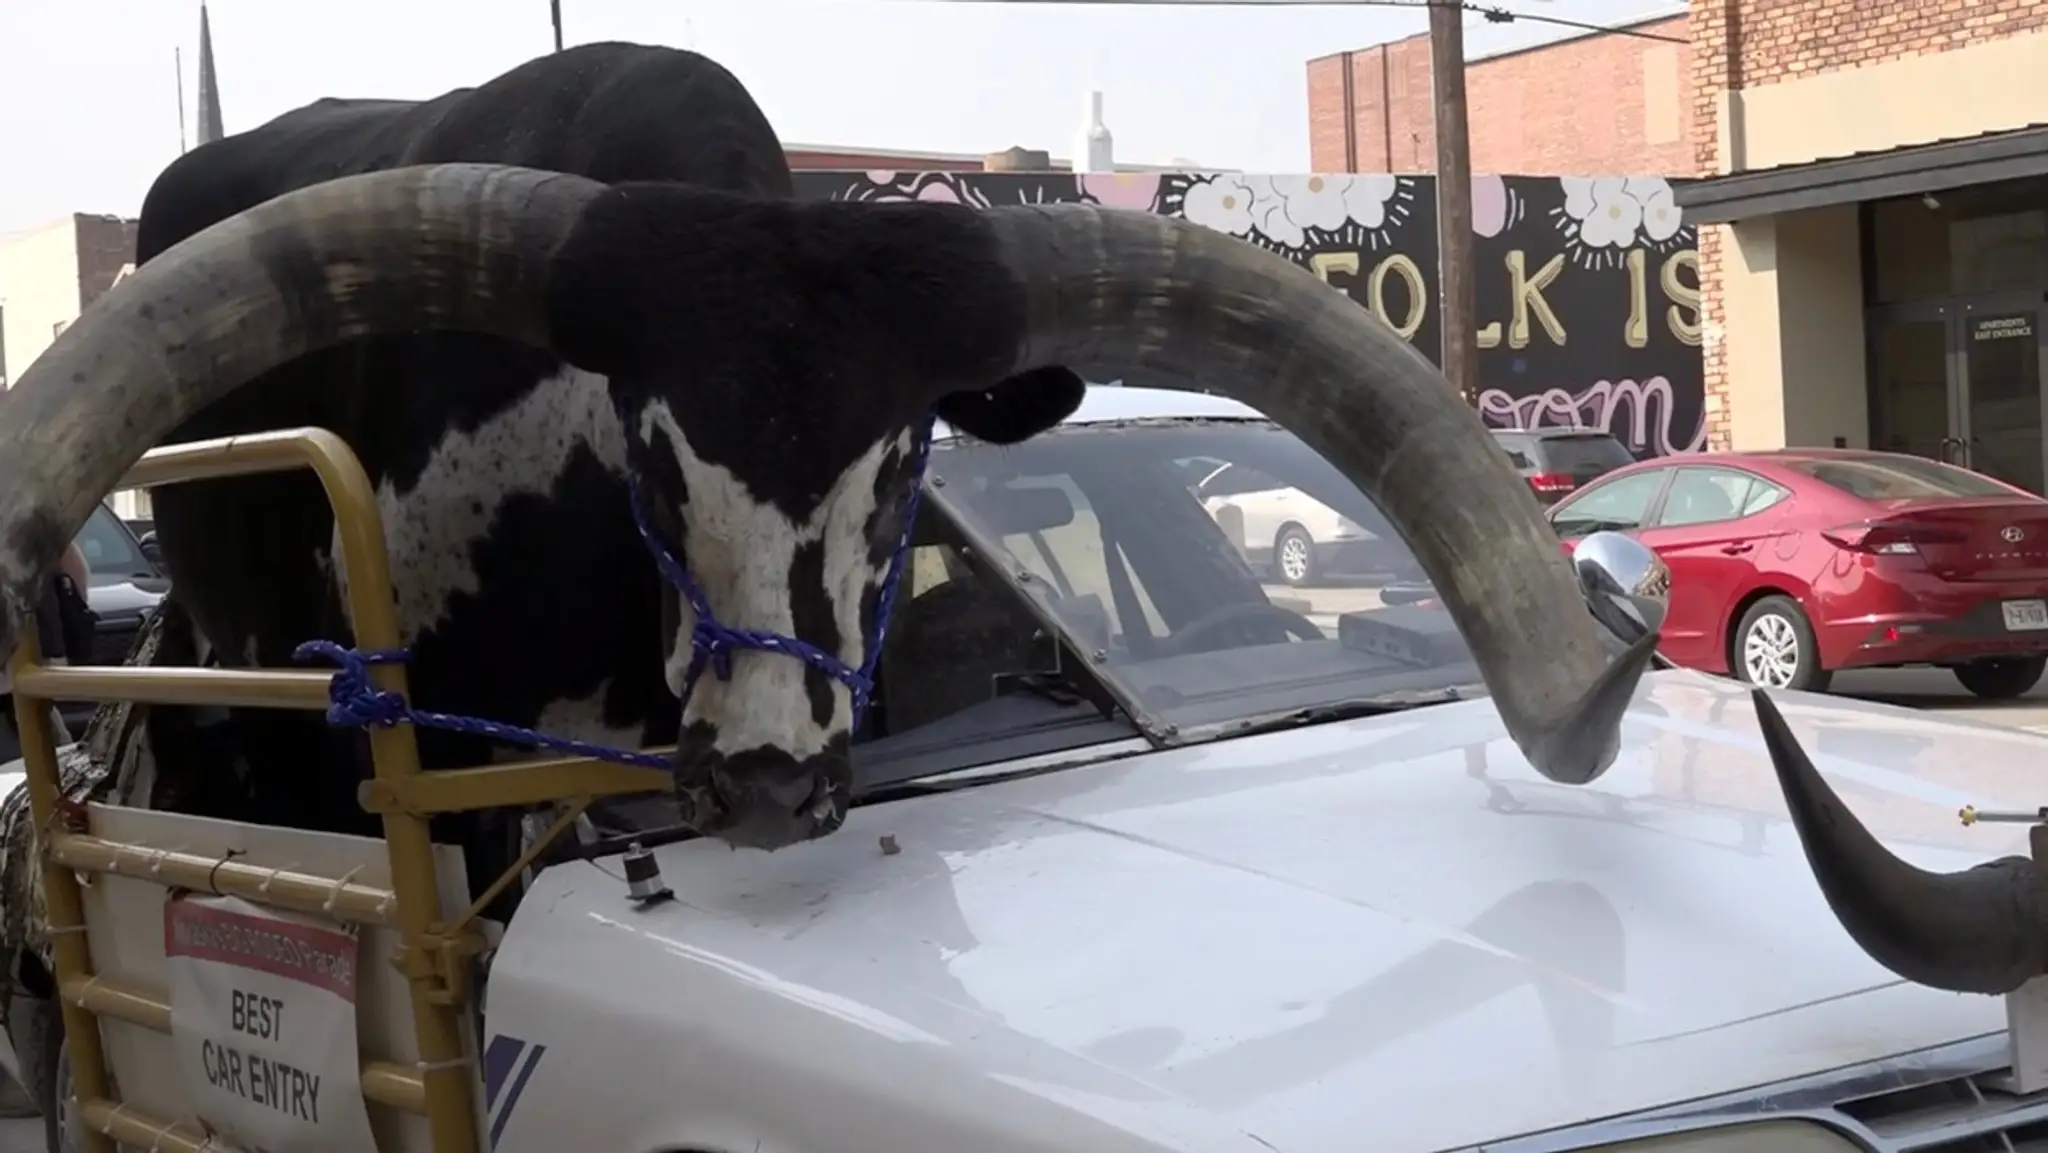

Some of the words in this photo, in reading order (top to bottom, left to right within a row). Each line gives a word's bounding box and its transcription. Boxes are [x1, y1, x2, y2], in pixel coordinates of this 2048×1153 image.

[1309, 250, 1567, 349] FOK
[1625, 249, 1702, 348] IS
[1979, 317, 2026, 329] APARTMENTS
[1992, 326, 2032, 339] ENTRANCE
[232, 989, 284, 1042] BEST
[202, 1038, 246, 1098] CAR
[248, 1055, 320, 1124] ENTRY
